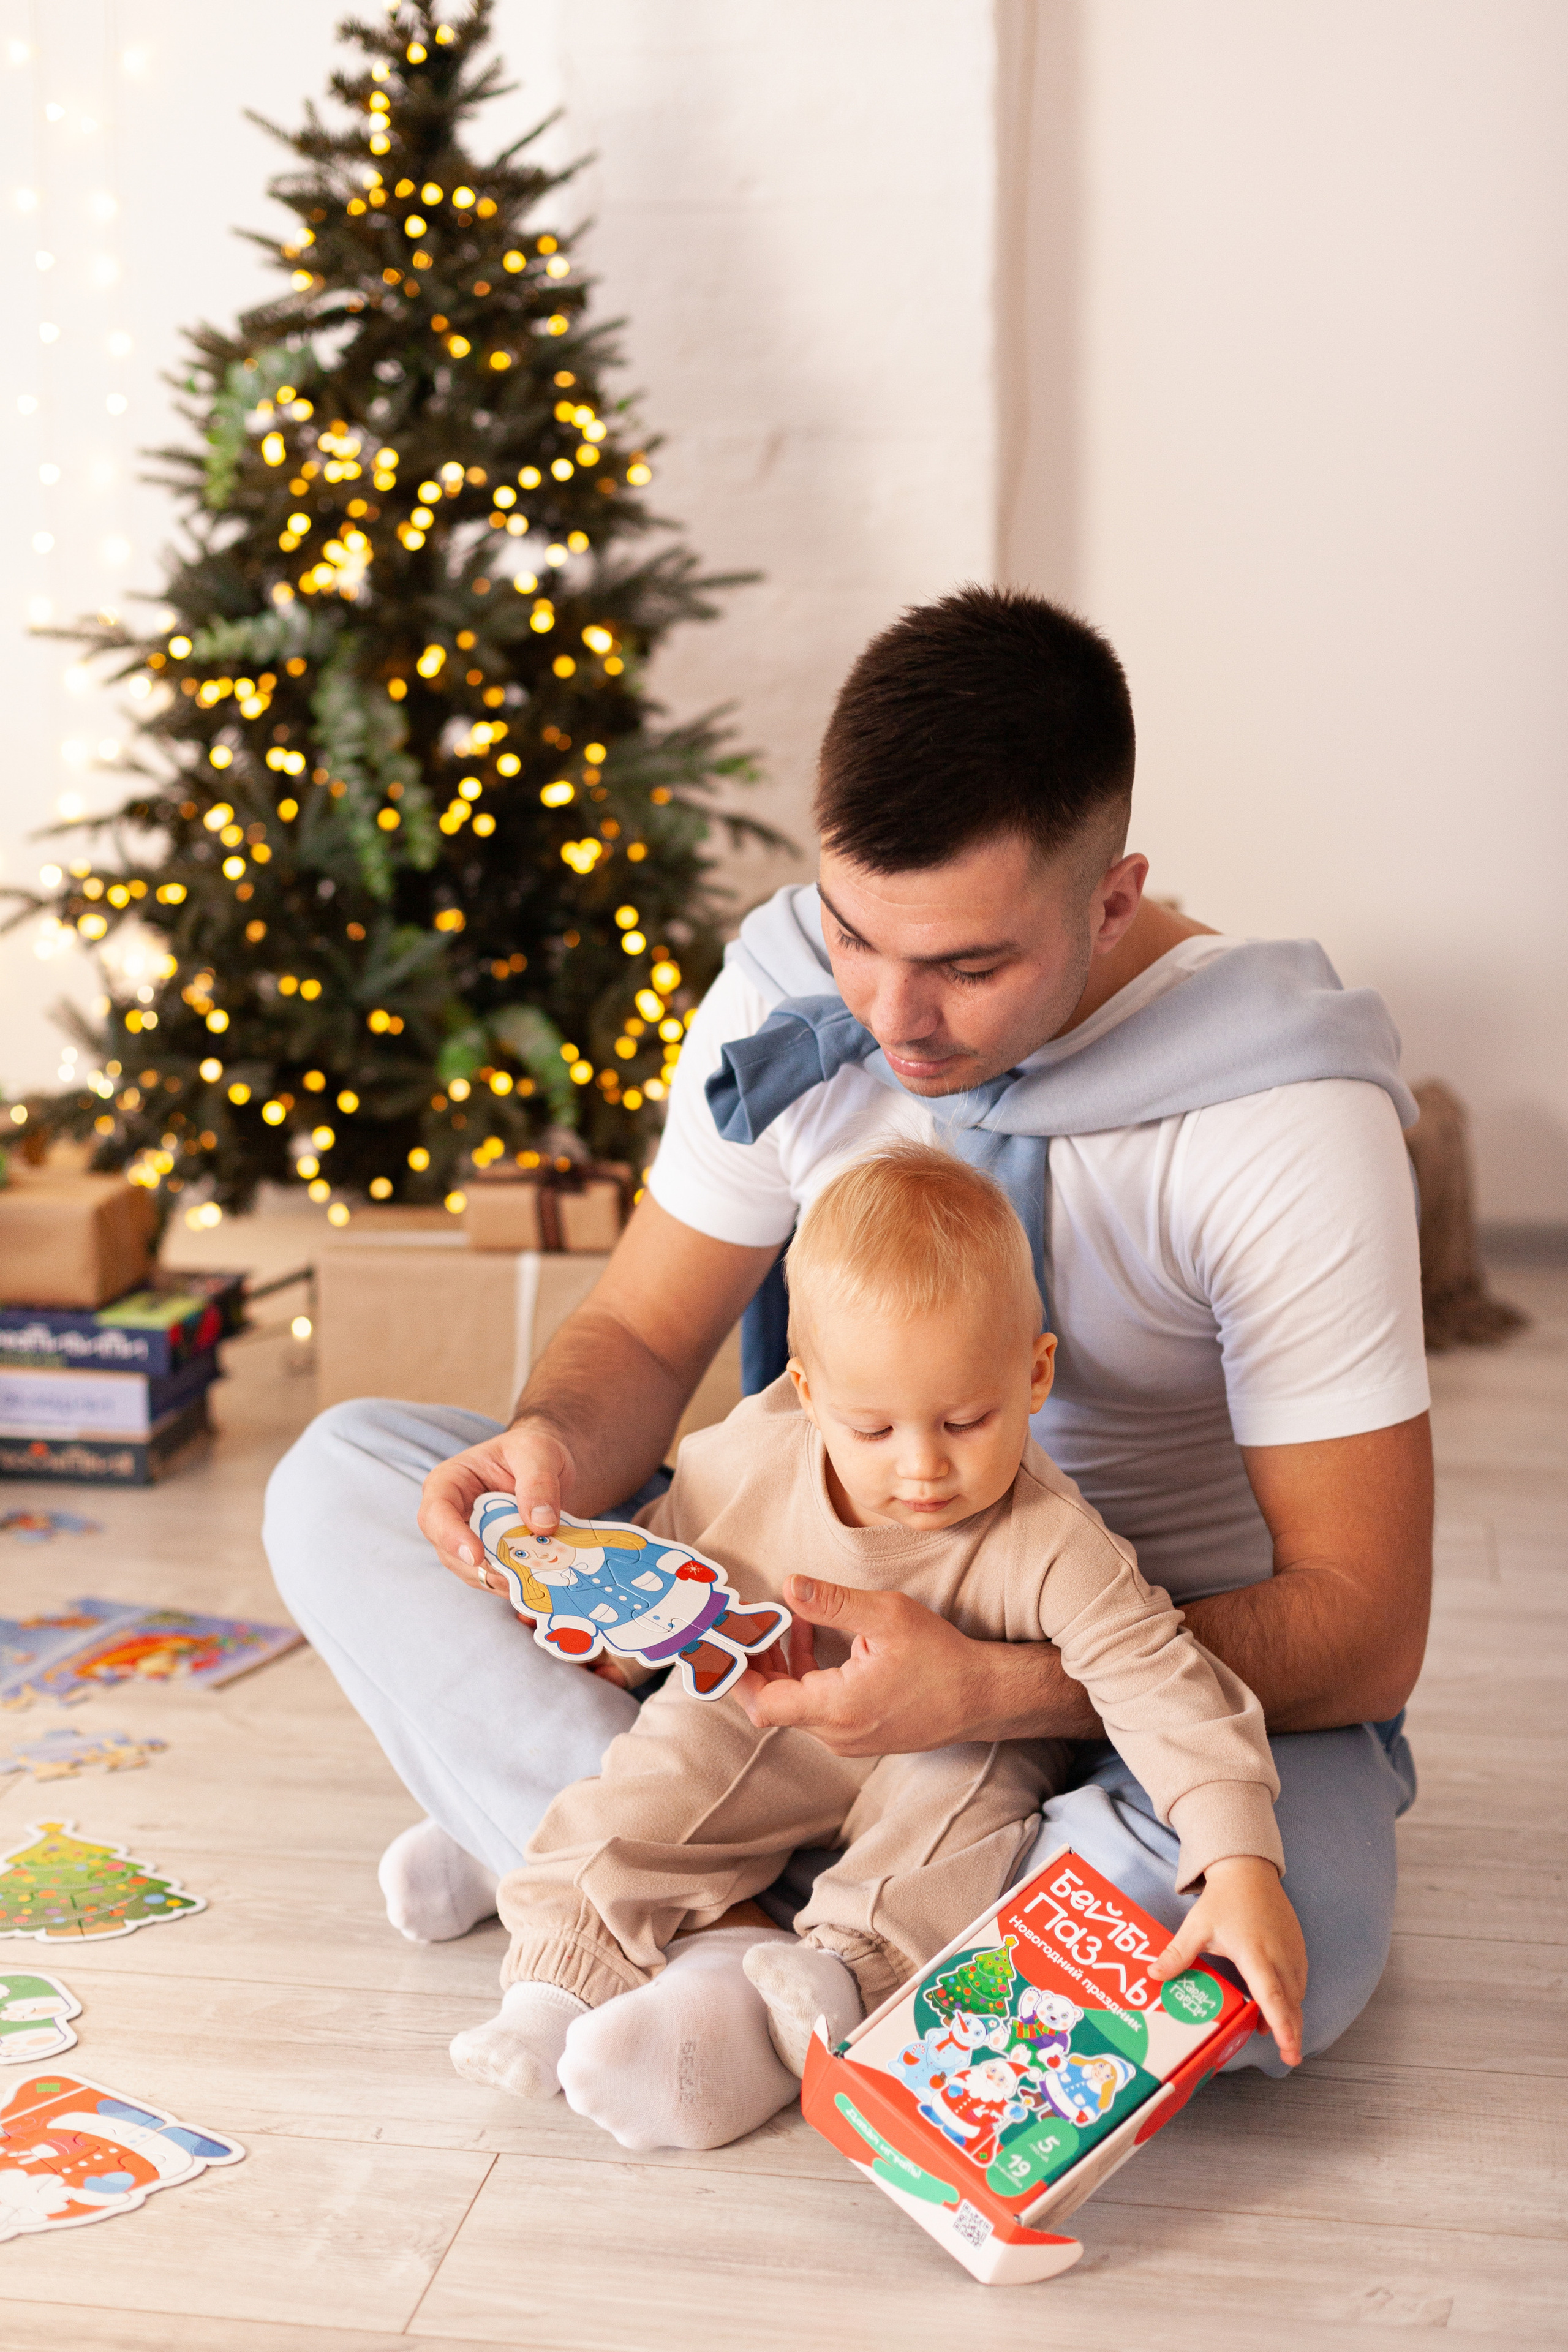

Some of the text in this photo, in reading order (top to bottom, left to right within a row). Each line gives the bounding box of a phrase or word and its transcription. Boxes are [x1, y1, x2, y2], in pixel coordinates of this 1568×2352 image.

[1008, 1915, 1142, 2032] Новогодний праздник
[1037, 2135, 1061, 2153] 5
[1008, 2154, 1031, 2177] 19
